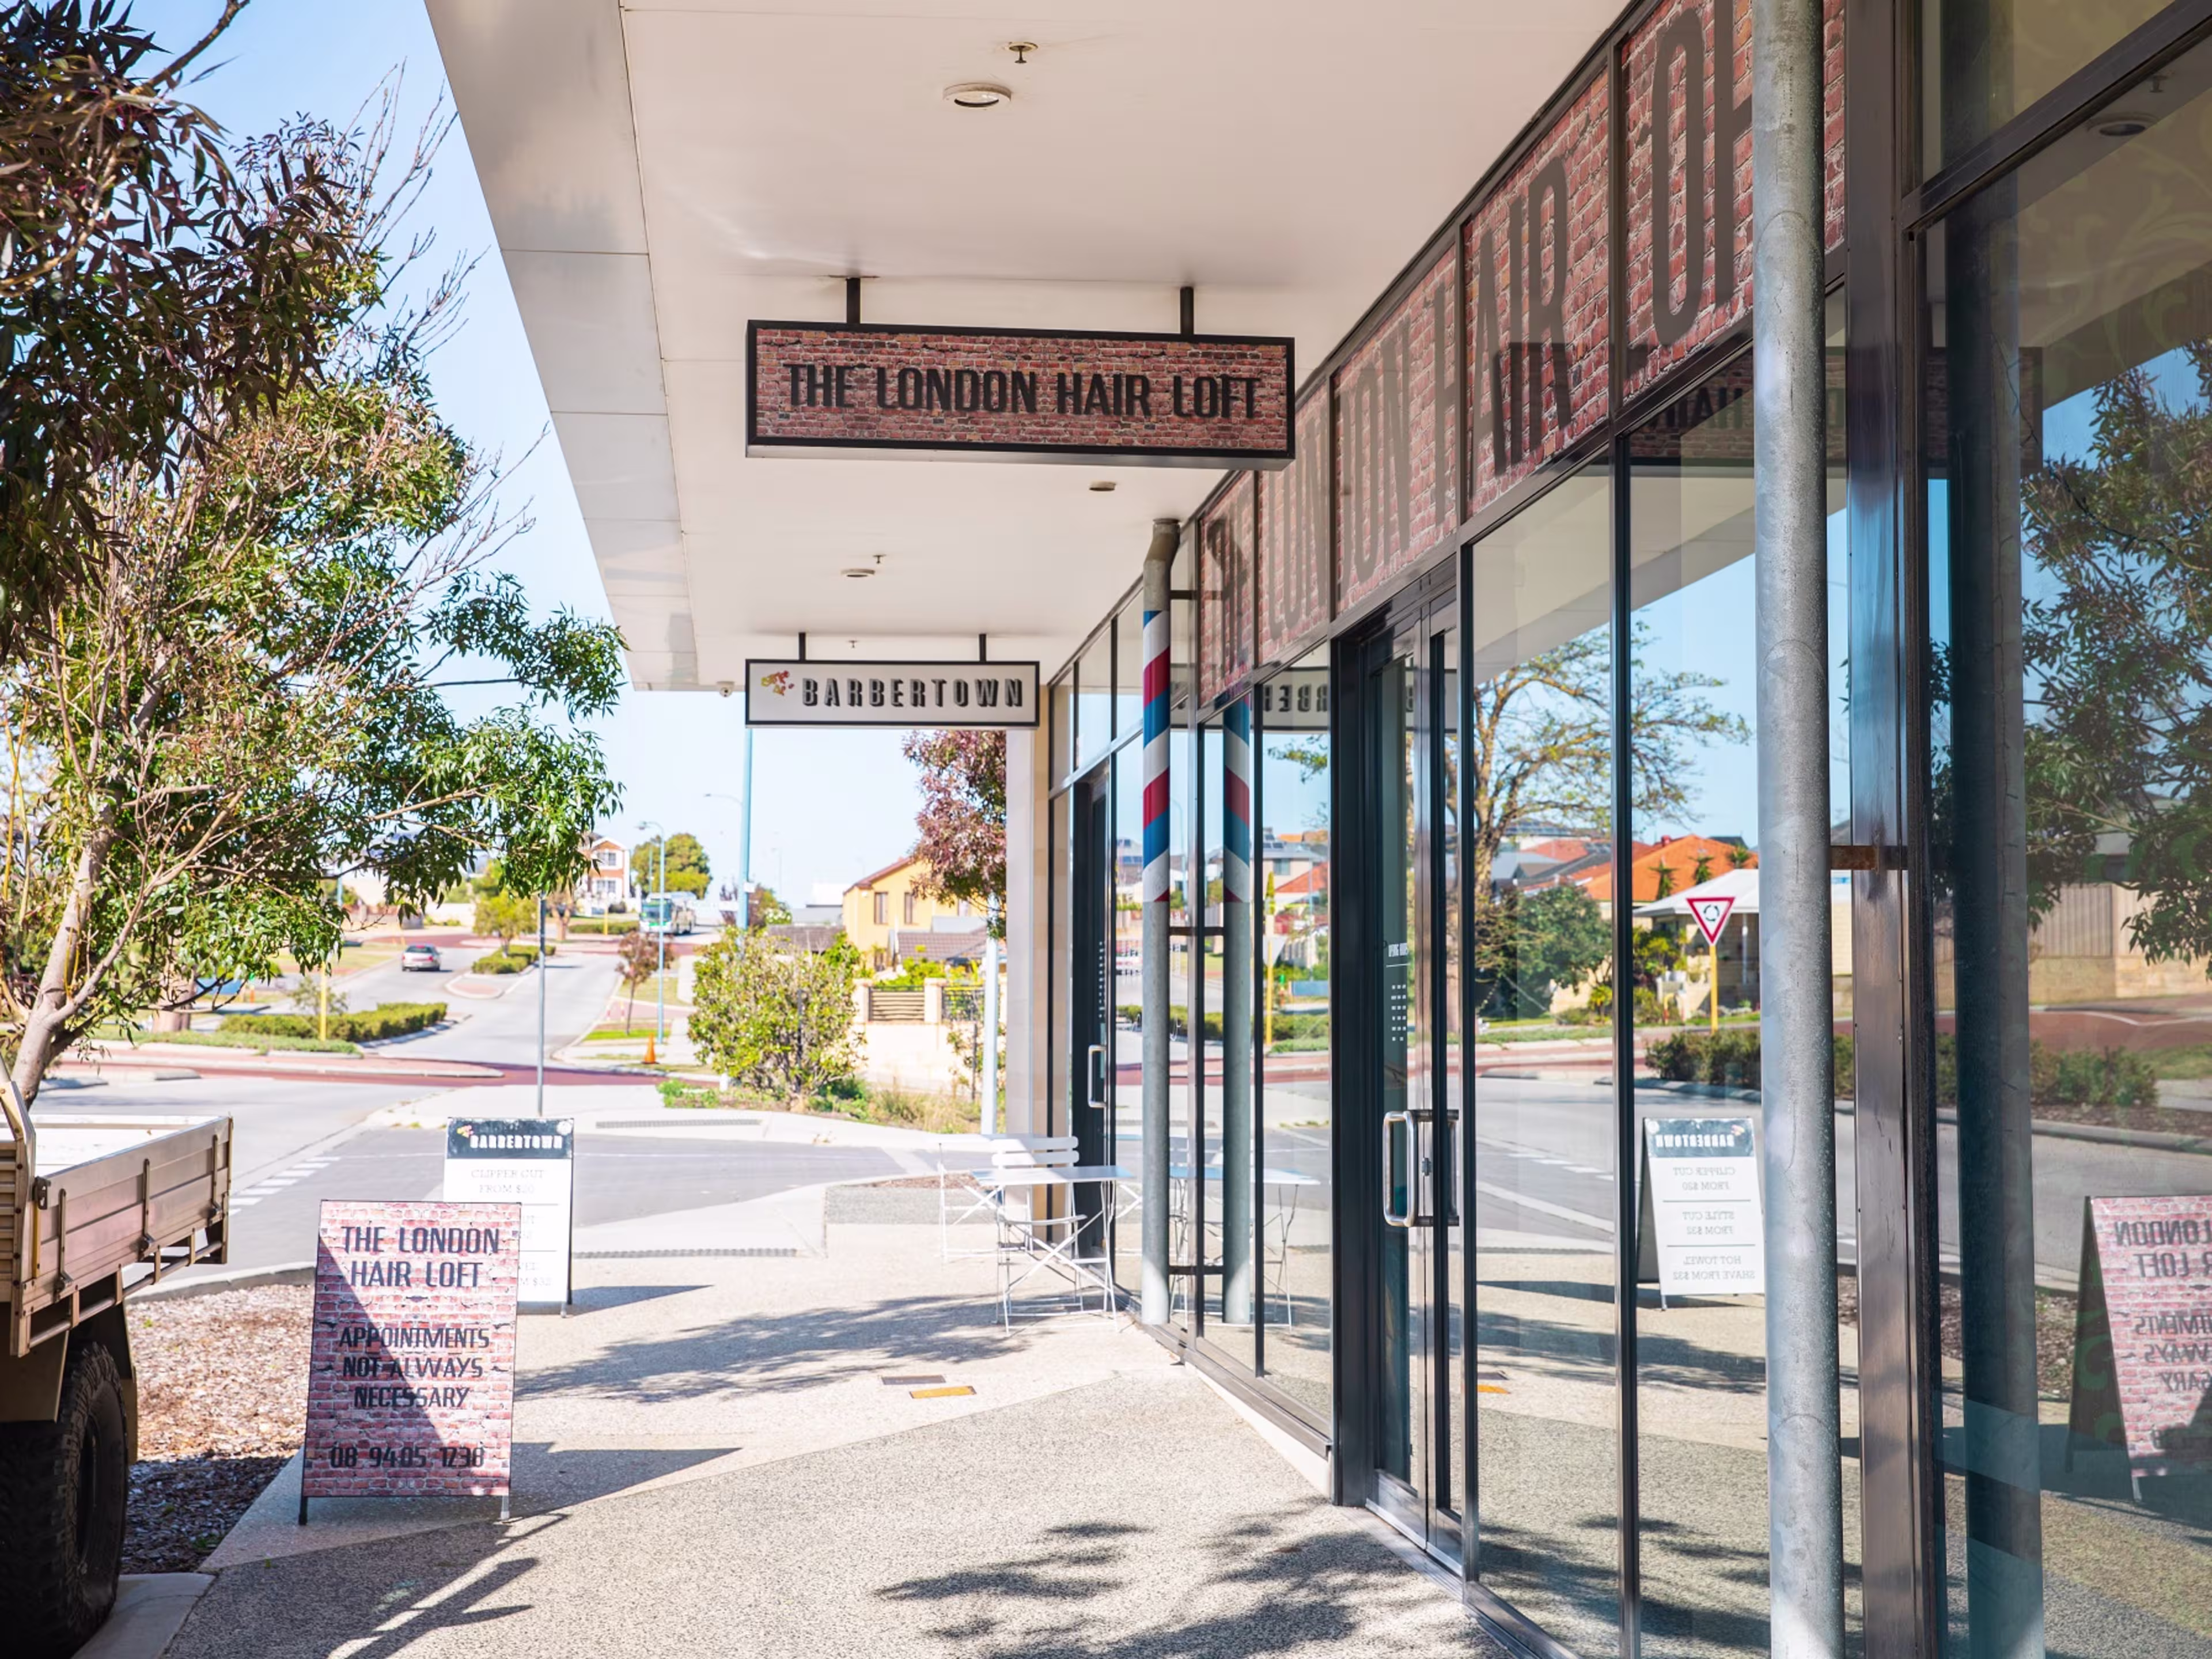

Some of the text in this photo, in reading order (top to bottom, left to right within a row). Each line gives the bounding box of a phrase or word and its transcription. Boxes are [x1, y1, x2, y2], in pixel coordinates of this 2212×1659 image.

[783, 363, 1260, 419] THE LONDON HAIR LOFT
[802, 678, 1023, 707] BARBERTOWN
[340, 1226, 499, 1254] THE LONDON
[351, 1260, 484, 1287] HAIR LOFT
[339, 1327, 490, 1348] APPOINTMENTS
[343, 1357, 484, 1378] NOT ALWAYS
[354, 1387, 471, 1408] NECESSARY
[329, 1446, 486, 1468] 08 9405 1238
